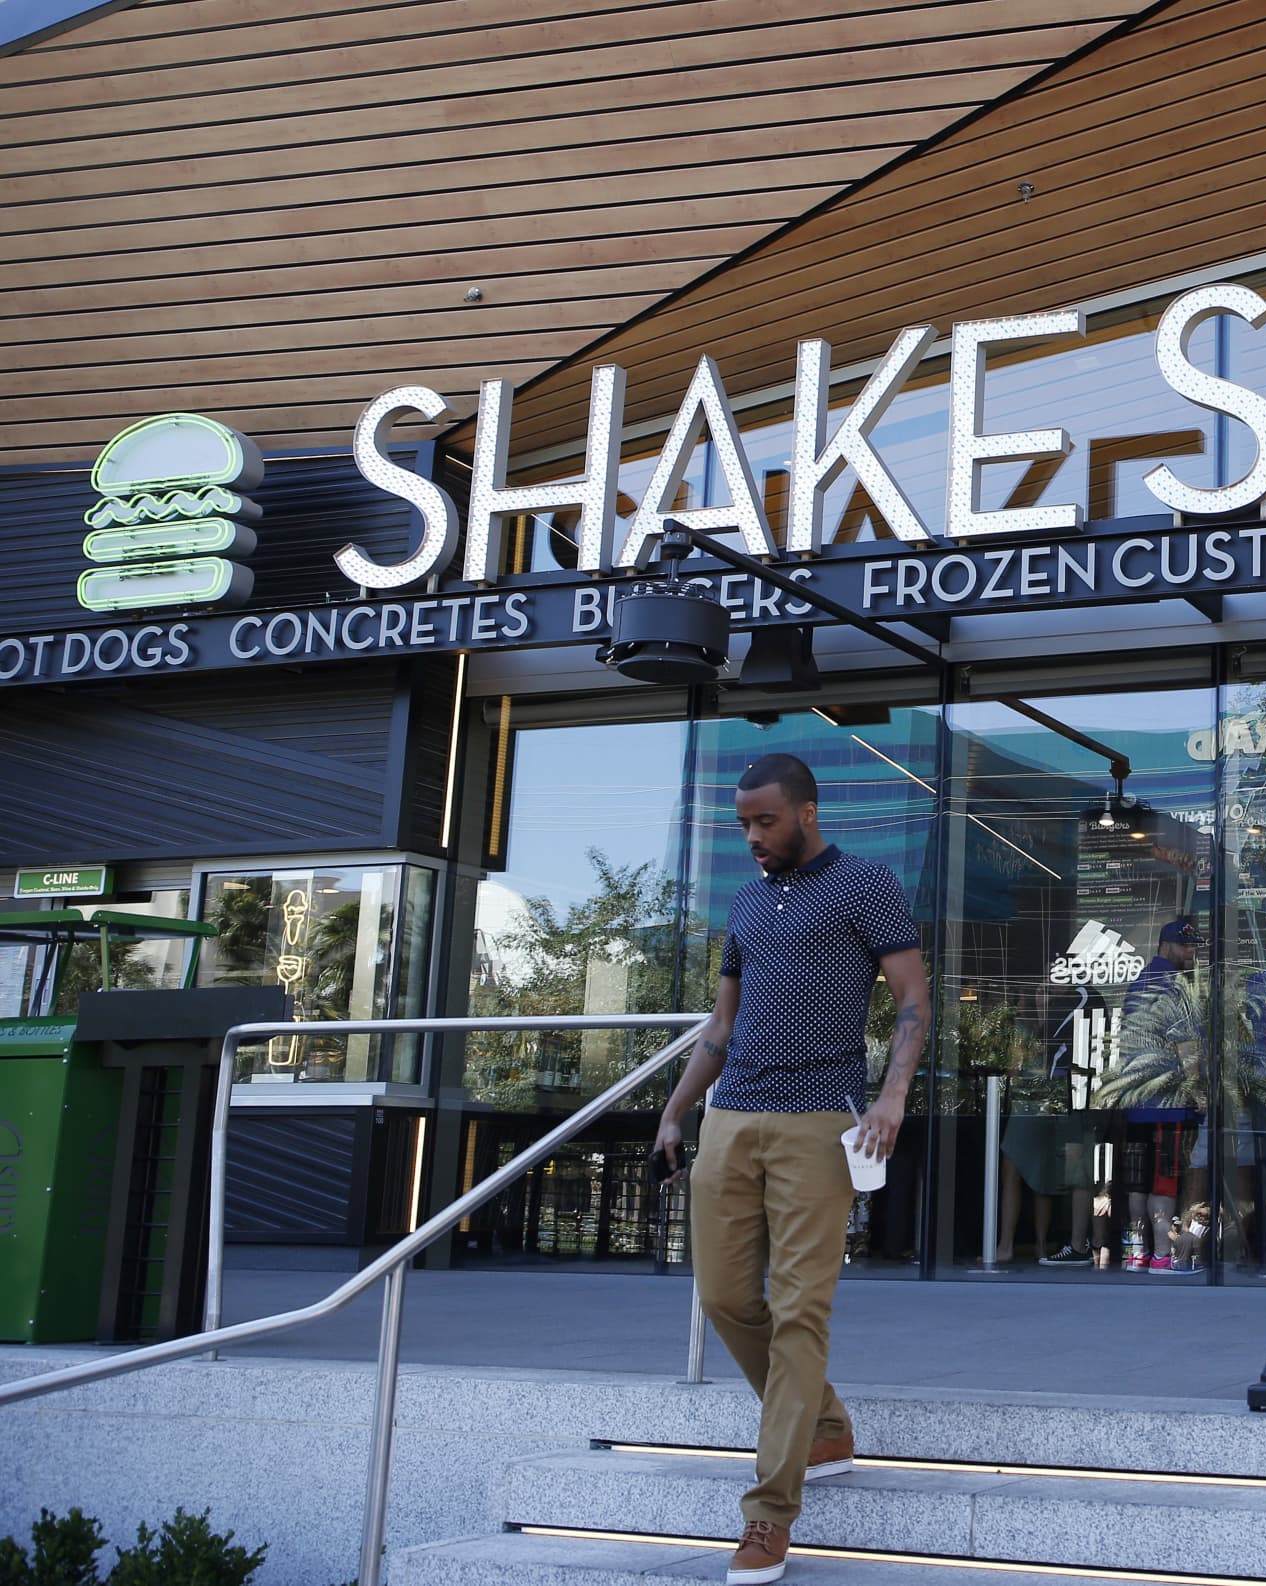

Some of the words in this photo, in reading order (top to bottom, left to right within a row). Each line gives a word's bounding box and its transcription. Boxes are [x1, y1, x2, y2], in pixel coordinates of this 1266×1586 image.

[334, 309, 1086, 592] SHAKE
[61, 623, 189, 674] DOGS
[229, 592, 529, 660] CONCRETES
[572, 567, 814, 634] BERS
[862, 543, 1096, 610] FROZEN
[43, 872, 79, 885] C-LINE
